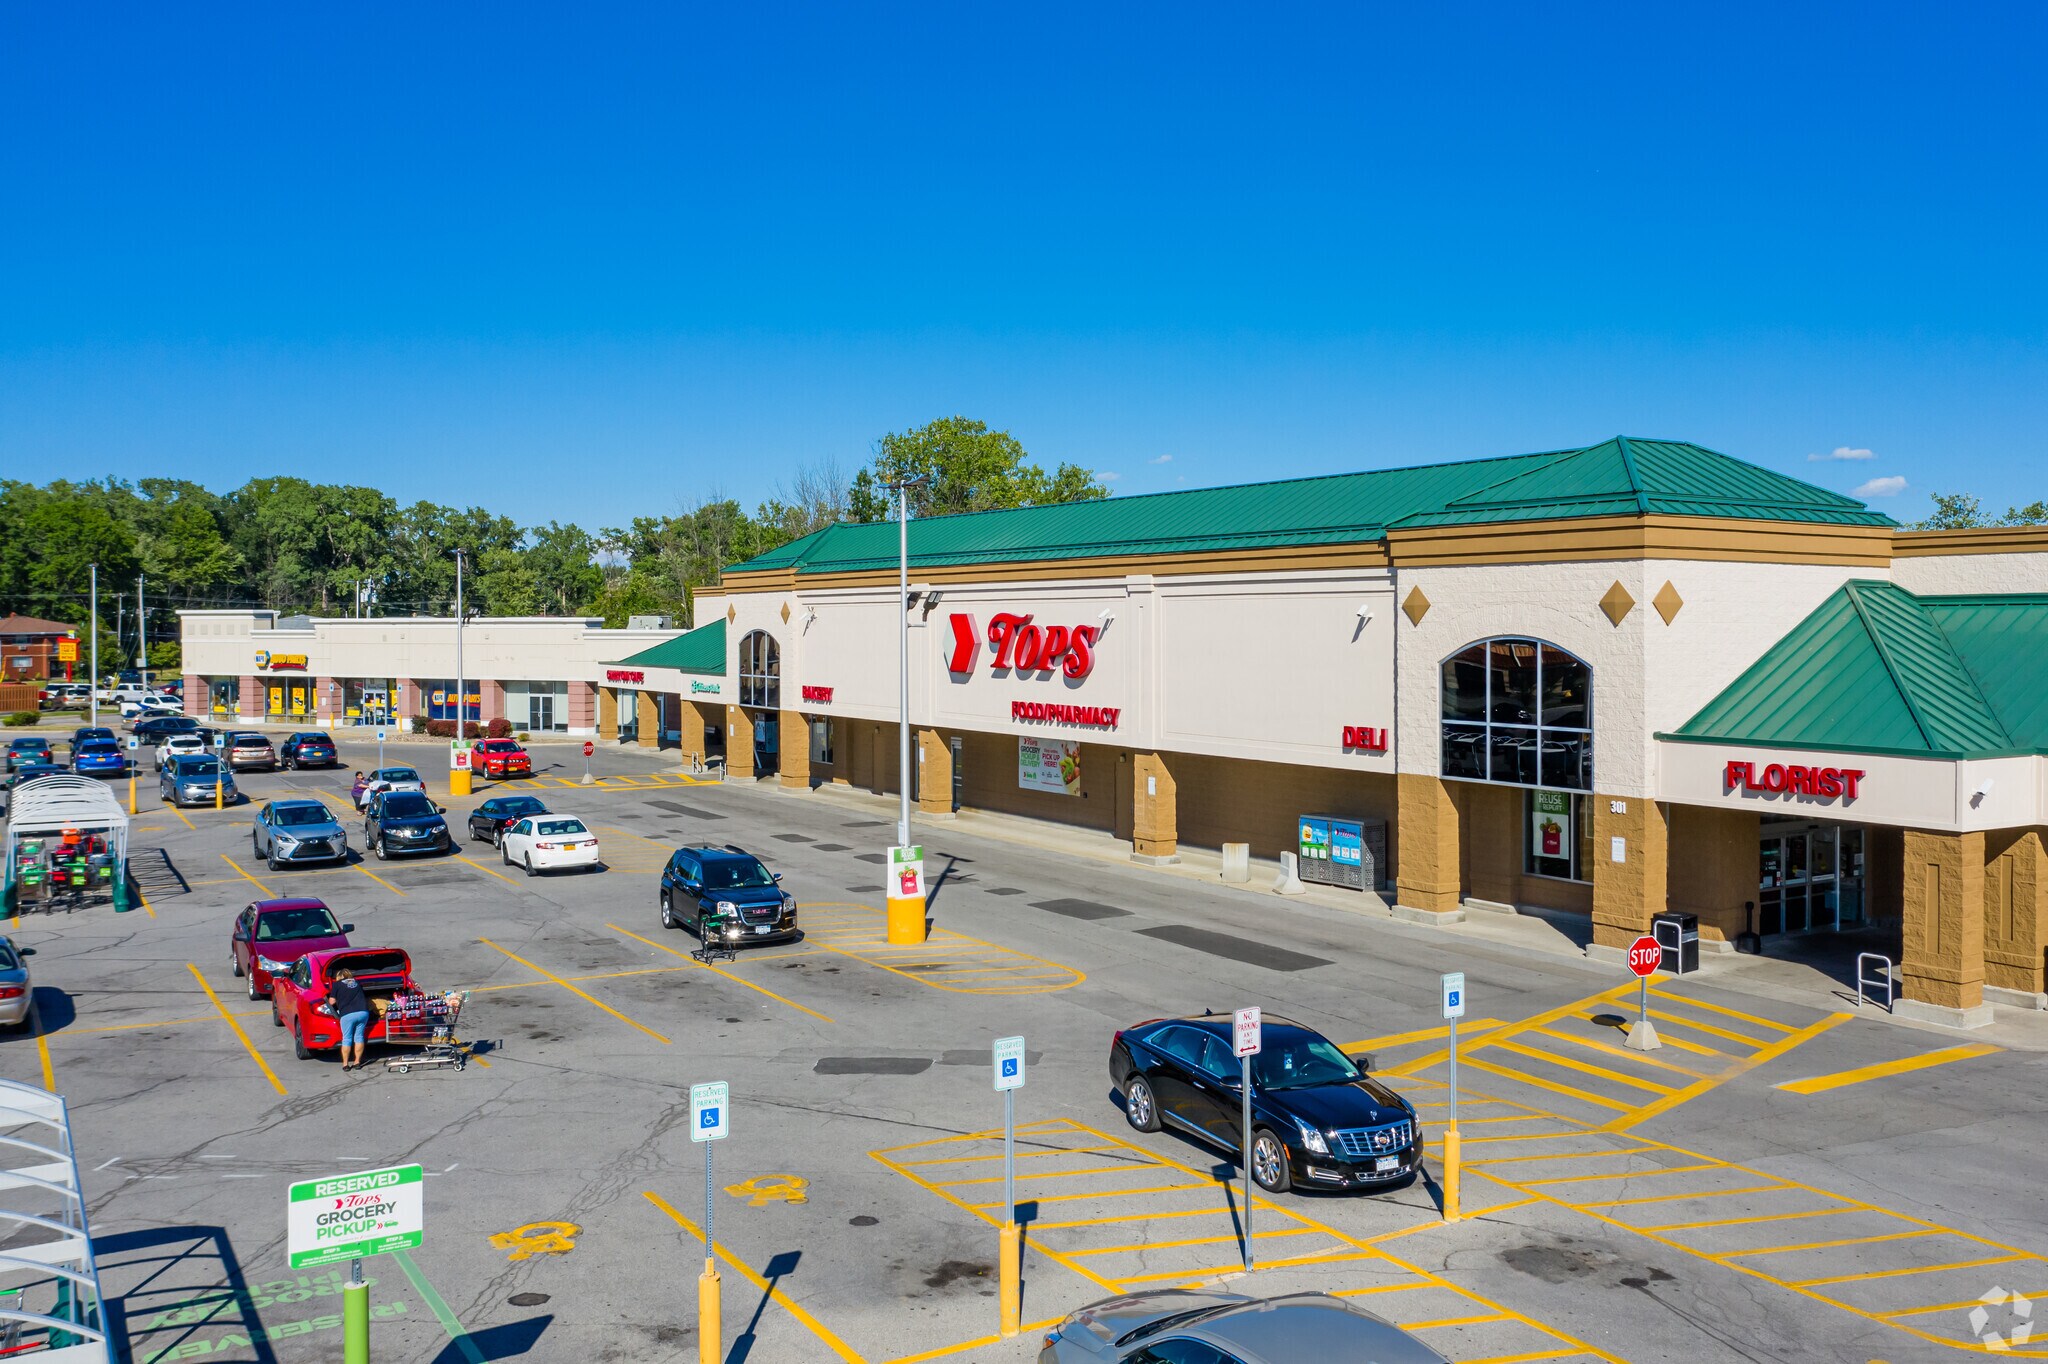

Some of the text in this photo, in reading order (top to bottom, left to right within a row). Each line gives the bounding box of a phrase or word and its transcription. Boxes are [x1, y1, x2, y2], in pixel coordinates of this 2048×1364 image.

[802, 685, 834, 701] BAKERY
[1011, 701, 1121, 727] FOOD/PHARMACY
[1343, 726, 1388, 751] DELI
[1020, 746, 1040, 754] GROCERY
[1727, 761, 1866, 798] FLORIST
[1539, 793, 1562, 804] REUSE
[1543, 803, 1562, 811] REPEAT
[1610, 800, 1626, 814] 301
[1630, 947, 1660, 966] STOP
[1243, 1011, 1253, 1021] NO
[1237, 1020, 1259, 1031] PARKING
[995, 1040, 1023, 1051] RESERVED
[1243, 1037, 1253, 1045] TIME
[997, 1049, 1022, 1058] PARKING
[695, 1088, 726, 1098] RESERVED
[696, 1097, 724, 1107] PARKING
[315, 1172, 400, 1197] RESERVED
[316, 1201, 397, 1226] GROCERY
[316, 1219, 377, 1240] PICKUP
[142, 1300, 408, 1363] RSERVED
